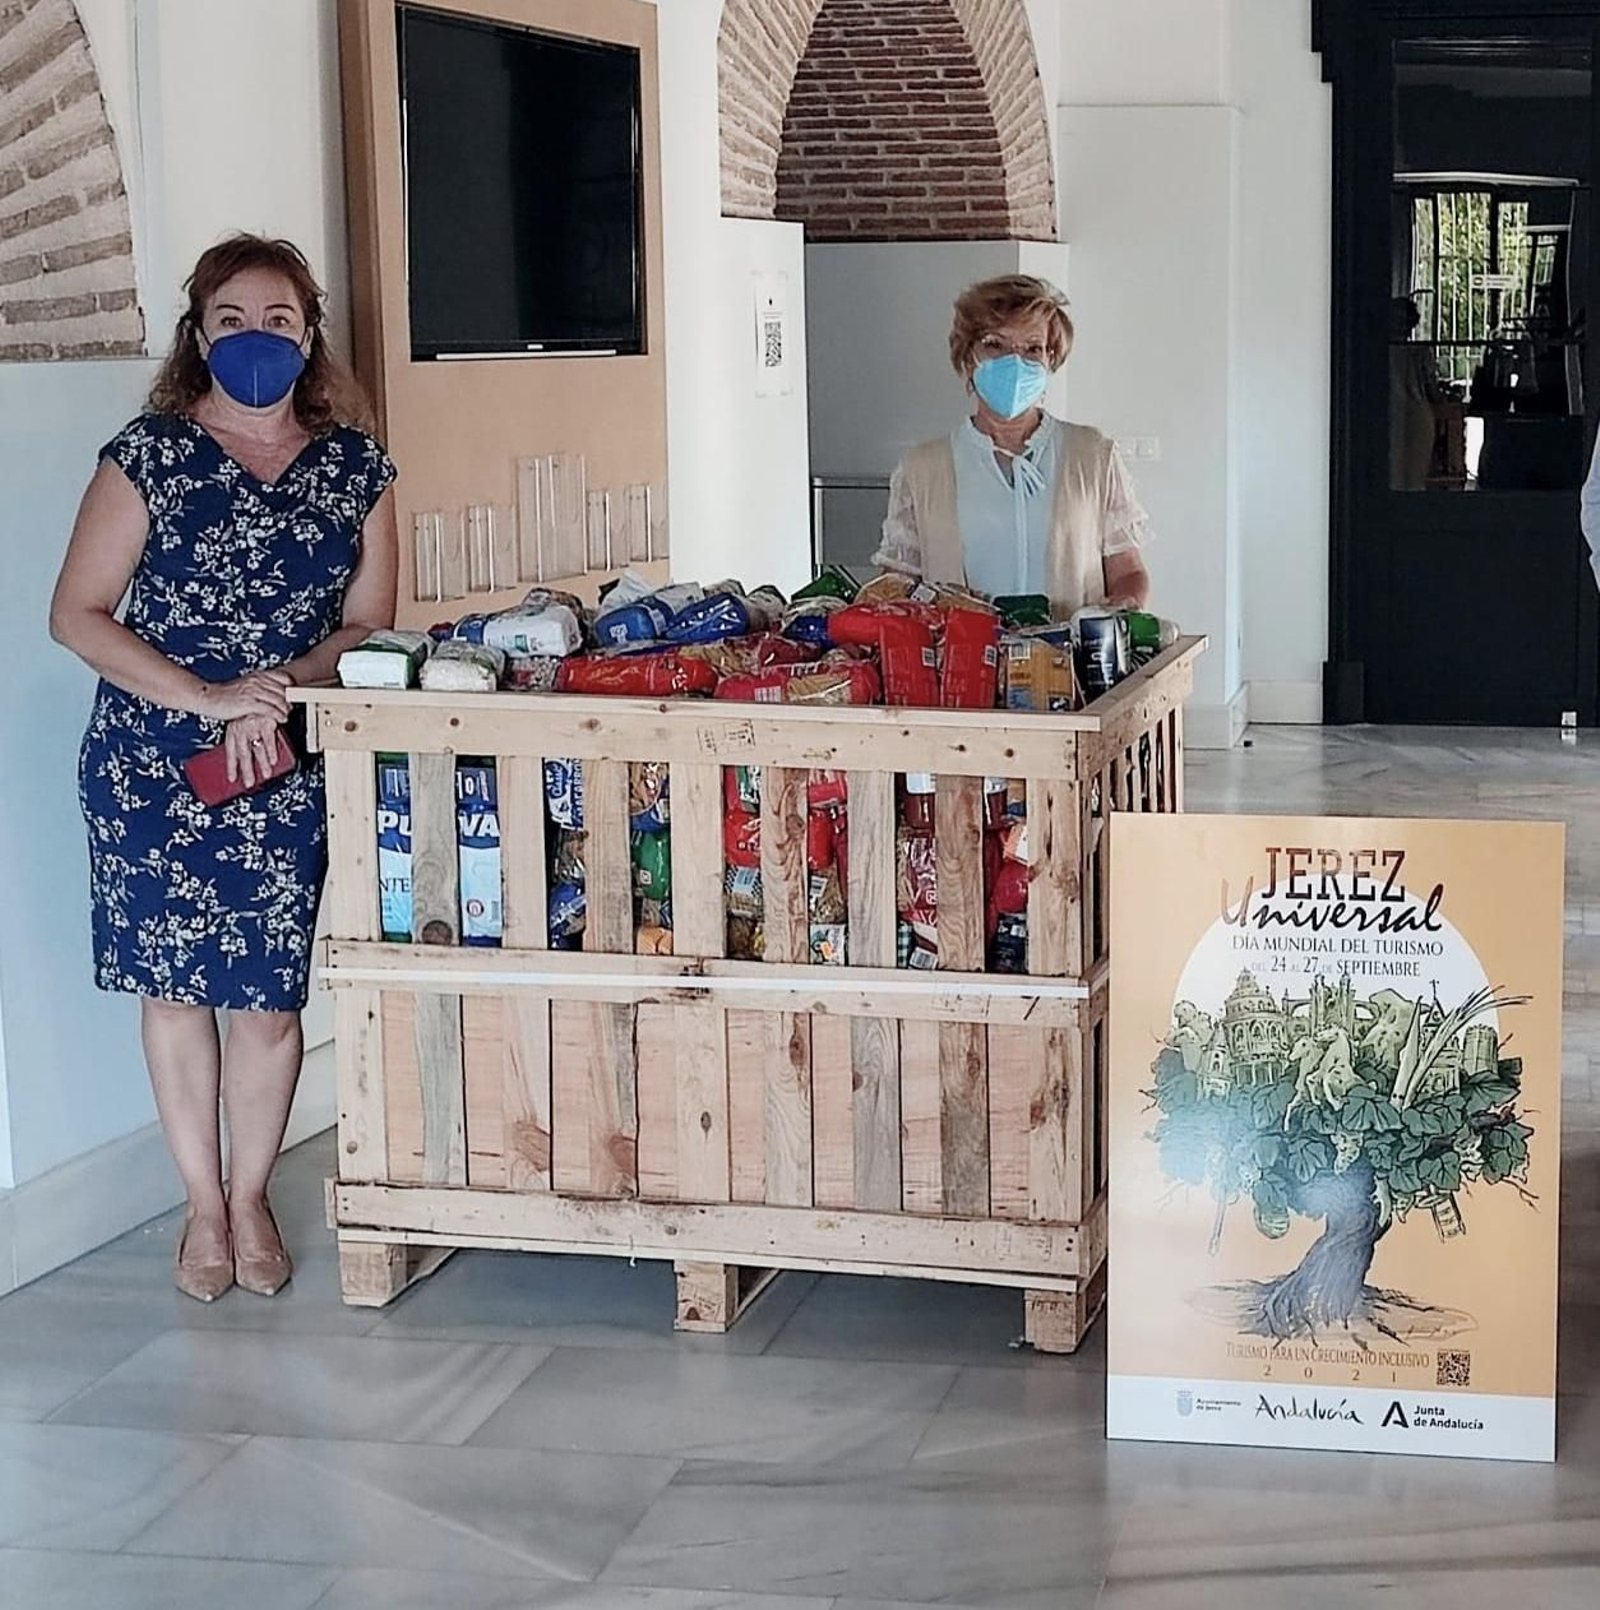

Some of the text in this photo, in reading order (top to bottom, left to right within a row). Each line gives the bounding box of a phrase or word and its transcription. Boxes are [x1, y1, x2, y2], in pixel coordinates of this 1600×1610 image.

[1262, 847, 1406, 902] JEREZ
[1221, 876, 1444, 934] Universal
[1233, 935, 1443, 956] DÍA MUNDIAL DEL TURISMO
[1271, 957, 1286, 972] 24
[1303, 957, 1318, 973] 27
[1336, 960, 1420, 976] SEPTIEMBRE
[1227, 1342, 1430, 1368] TURISMO PARA UN CRECIMIENTO INCLUSIVO
[1255, 1393, 1365, 1425] Andalucía
[1414, 1405, 1445, 1416] Junta
[1413, 1417, 1483, 1430] de Andalucía
